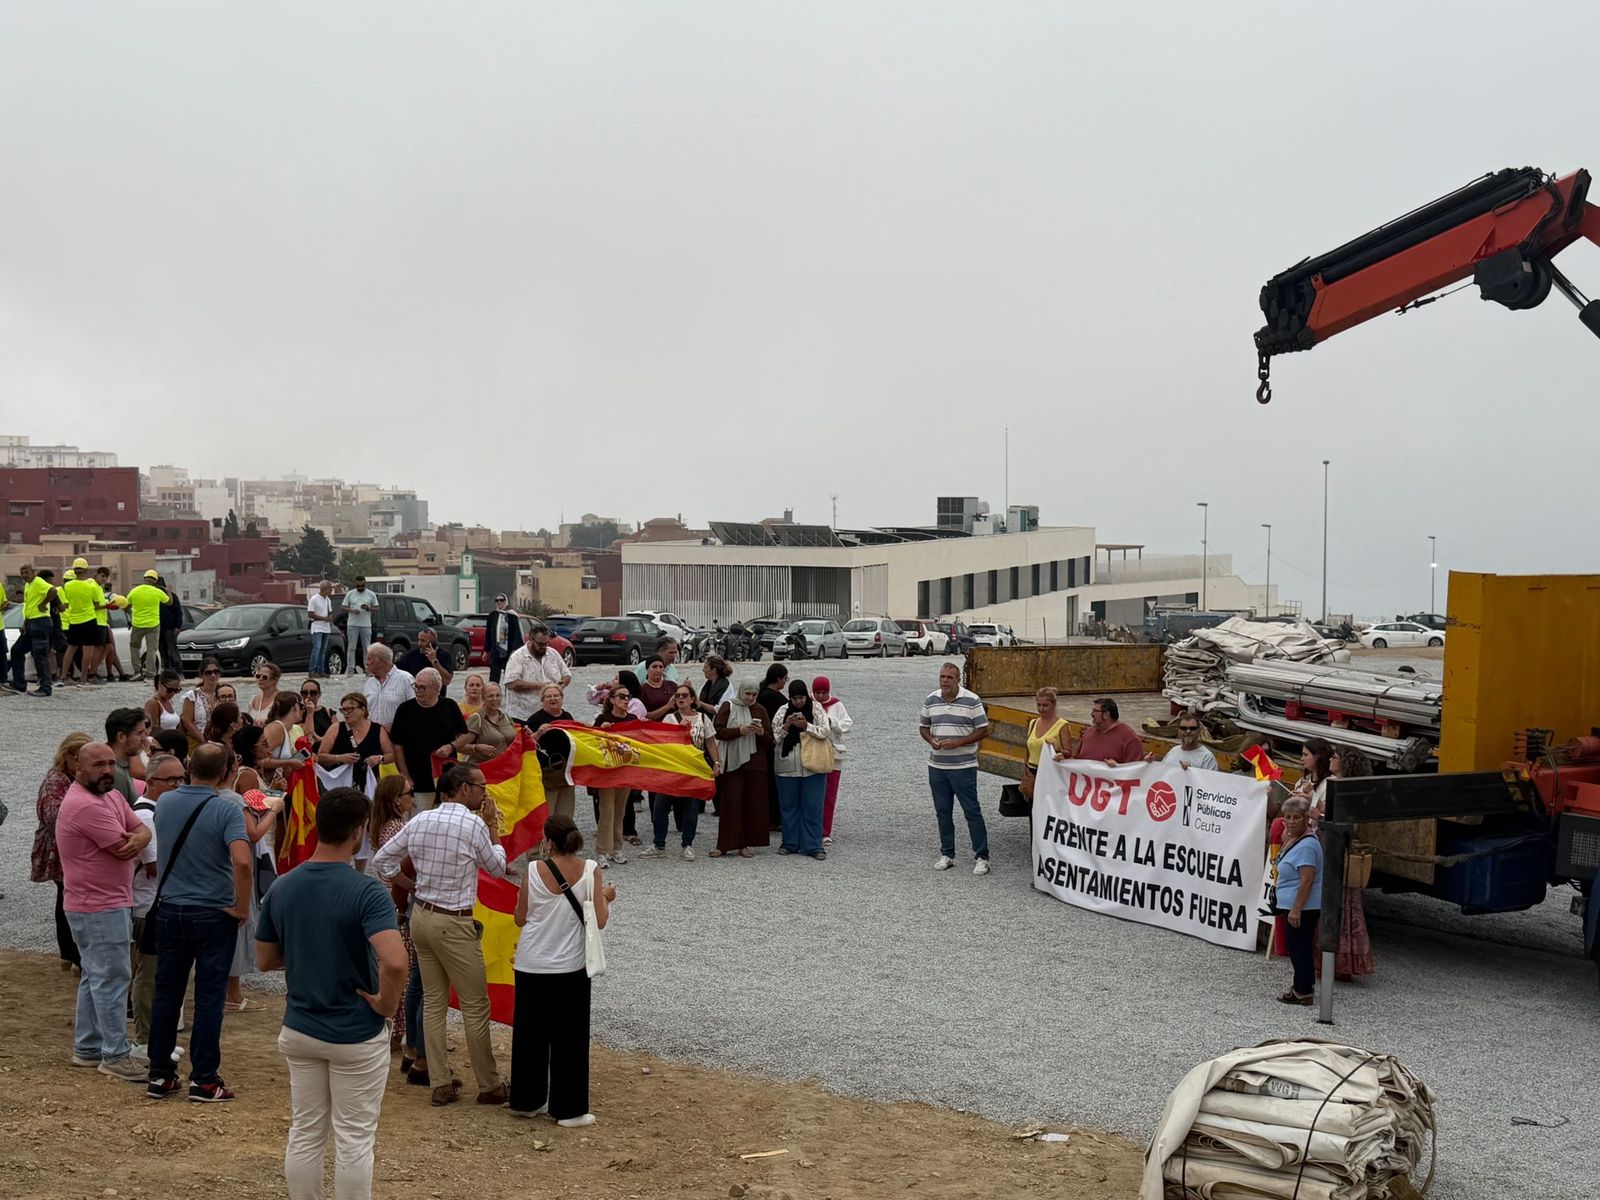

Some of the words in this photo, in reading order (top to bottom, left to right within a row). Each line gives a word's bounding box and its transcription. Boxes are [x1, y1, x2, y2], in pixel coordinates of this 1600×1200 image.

[1068, 771, 1140, 816] UGT
[1196, 788, 1238, 806] Servicios
[1194, 817, 1221, 834] Ceuta
[1196, 802, 1232, 820] Públicos
[1043, 815, 1109, 857] FRENTE
[1112, 834, 1127, 861] A
[1133, 837, 1156, 867] LA
[1163, 842, 1243, 888] ESCUELA
[1037, 854, 1184, 917] ASENTAMIENTOS
[1189, 892, 1248, 934] FUERA
